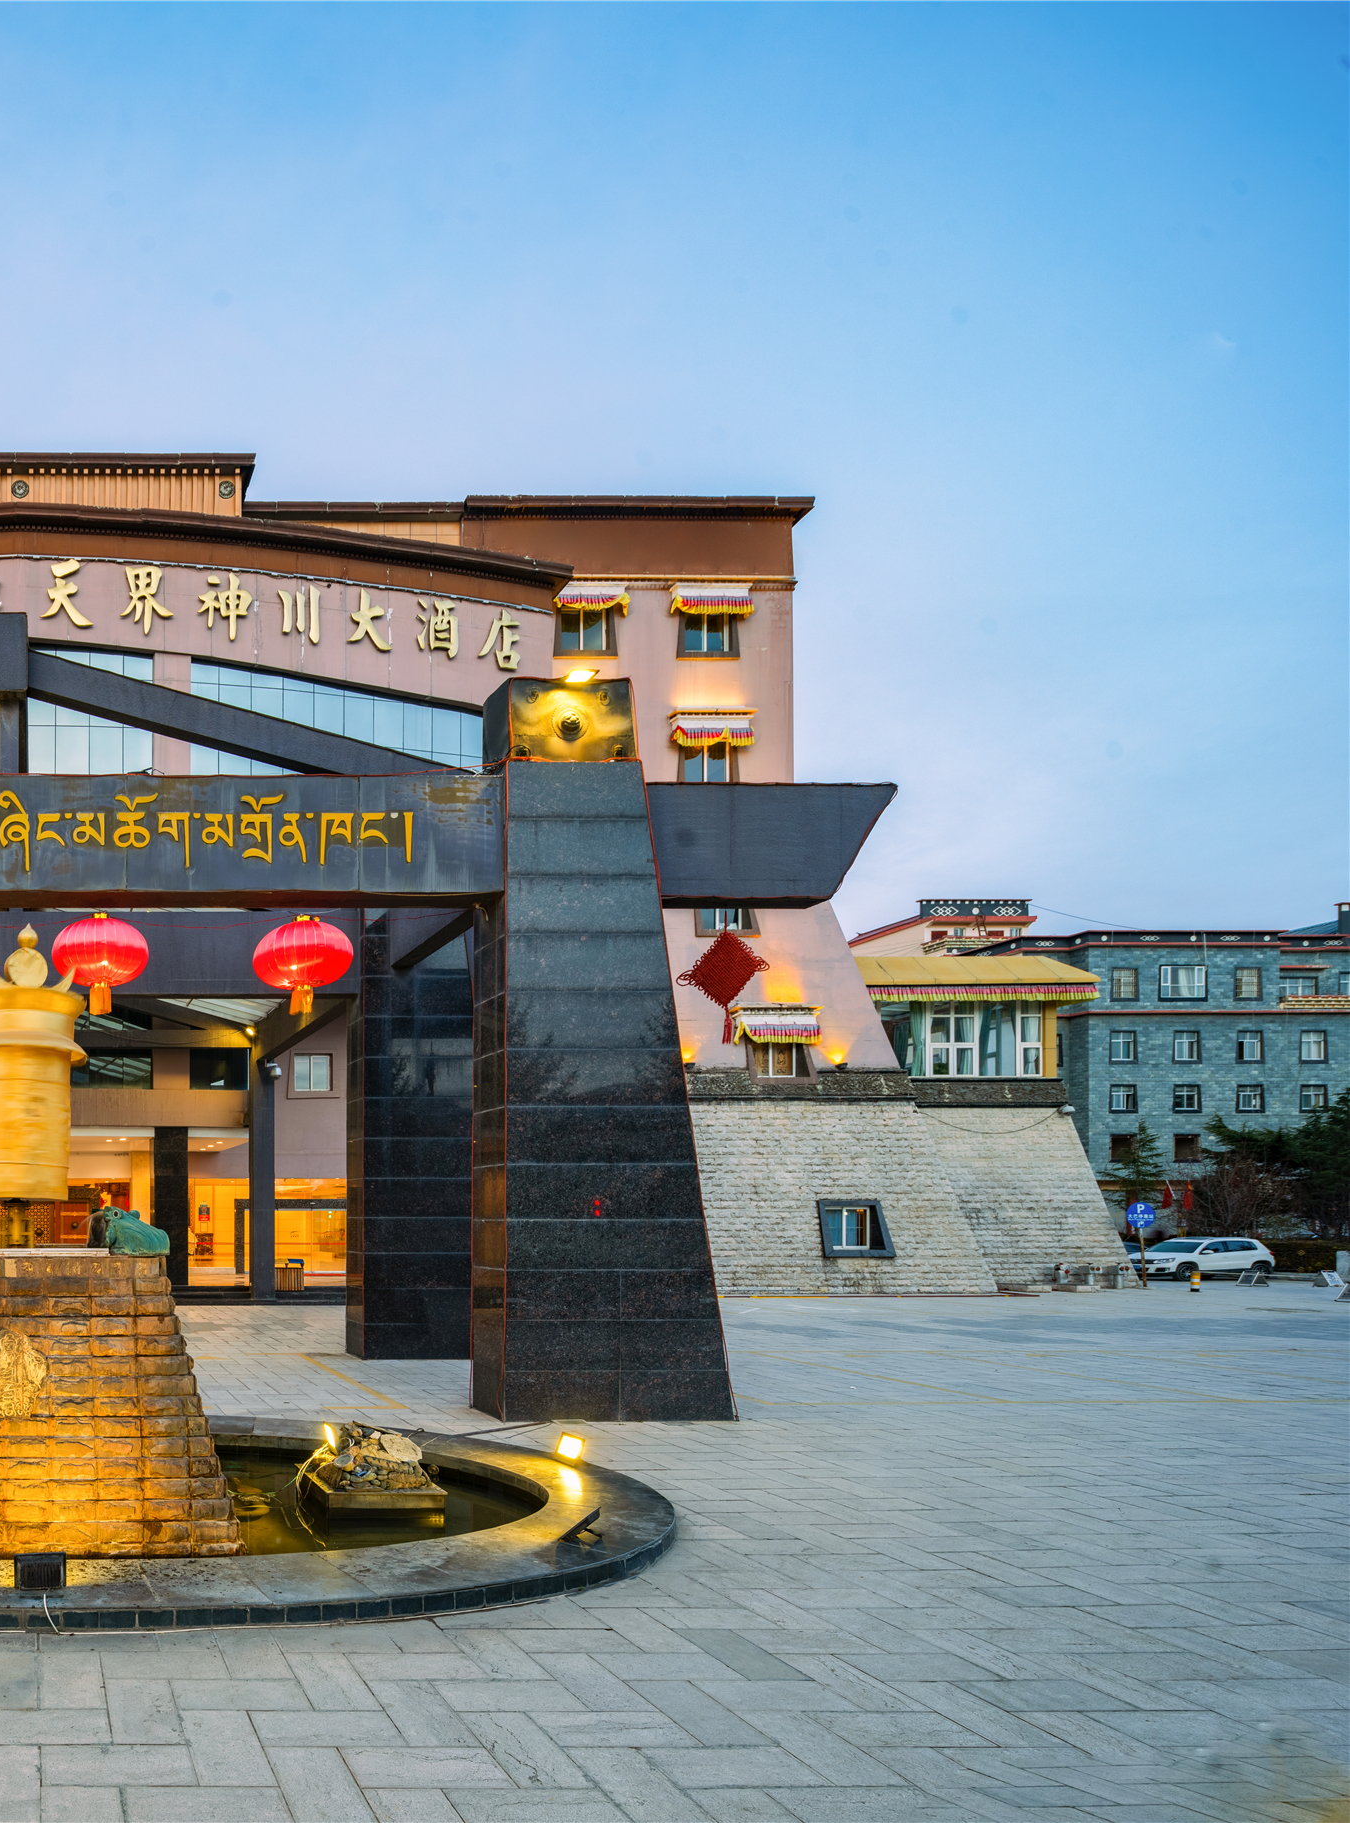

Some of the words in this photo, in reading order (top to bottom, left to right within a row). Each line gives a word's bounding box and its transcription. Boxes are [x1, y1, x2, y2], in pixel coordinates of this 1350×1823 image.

[39, 558, 522, 671] 天界神川大酒店
[1137, 1204, 1145, 1213] P
